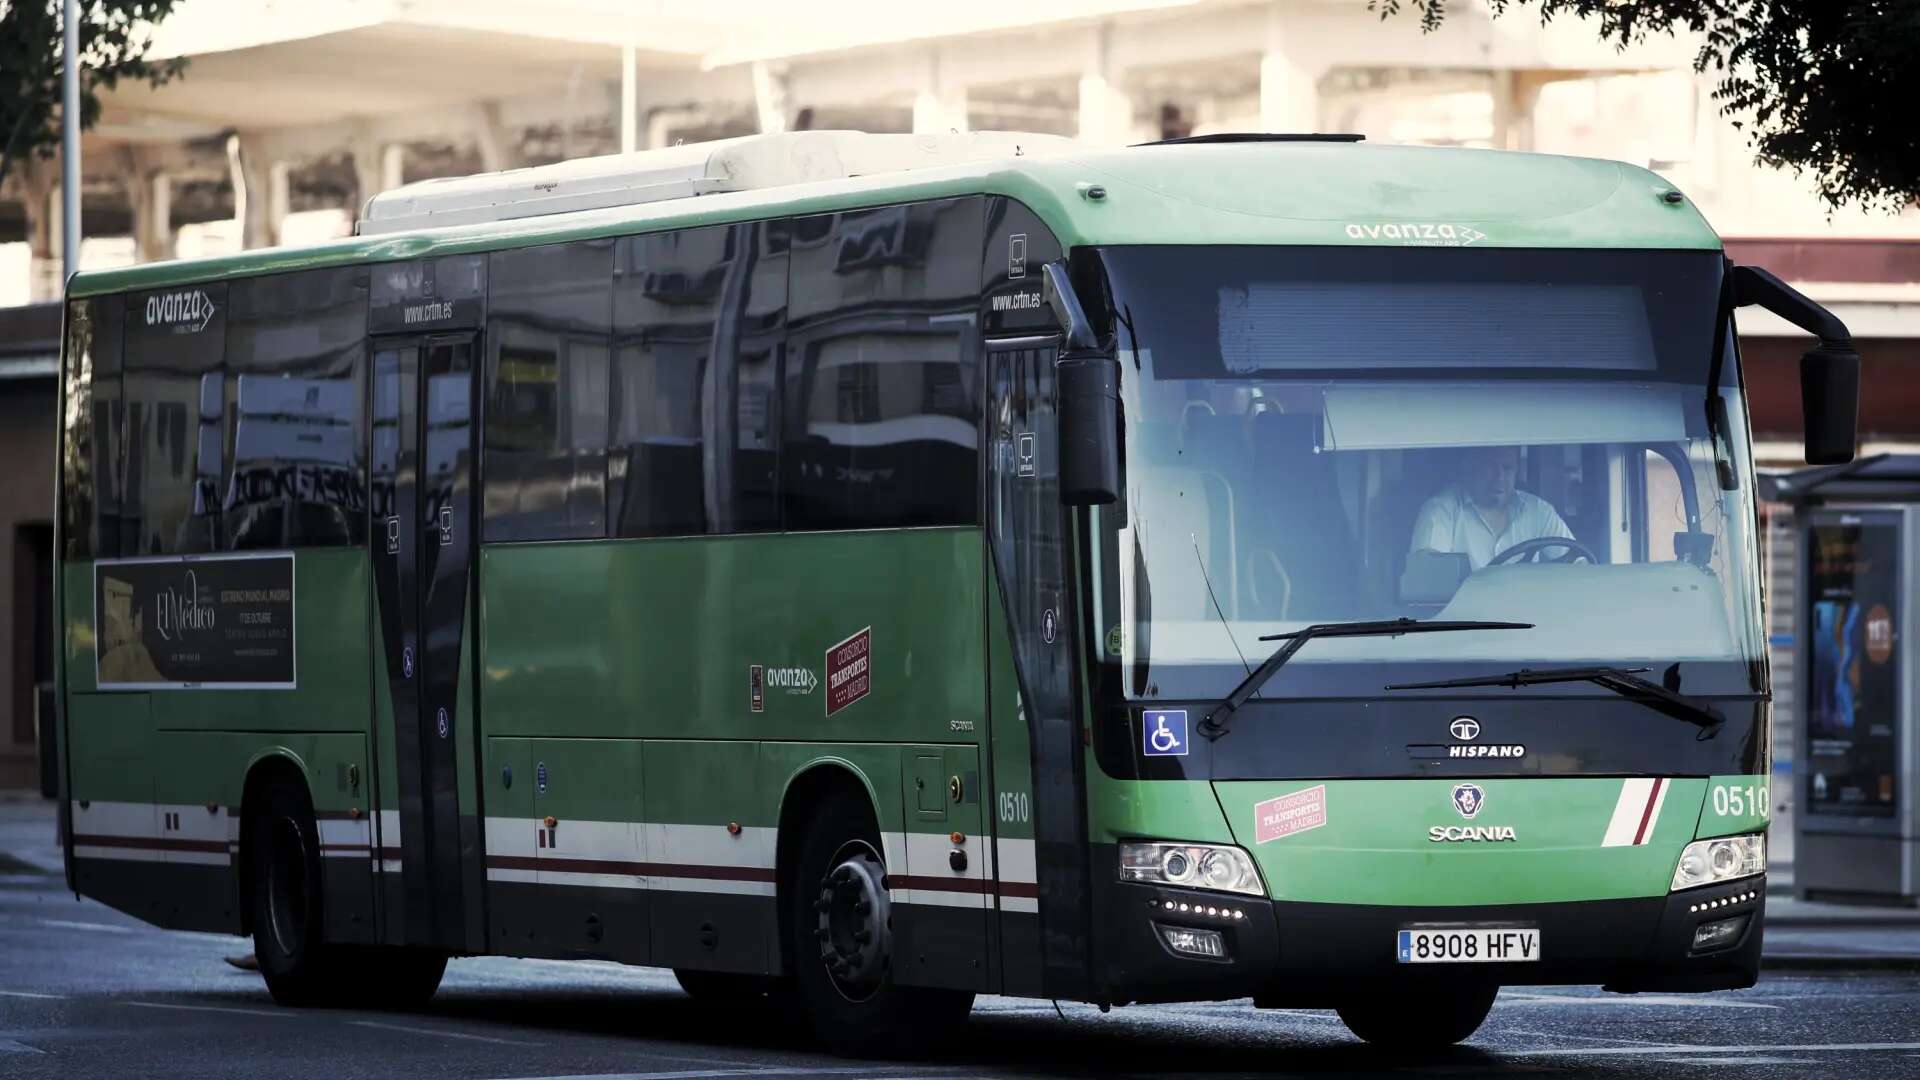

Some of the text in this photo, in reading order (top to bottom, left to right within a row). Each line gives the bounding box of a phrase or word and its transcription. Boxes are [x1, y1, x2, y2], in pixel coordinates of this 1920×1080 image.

[1345, 223, 1457, 239] avanza
[146, 289, 200, 326] avanza
[404, 300, 453, 324] www.crtm.es
[992, 291, 1041, 312] www.crtm.es
[837, 635, 868, 666] CONSORCIO
[767, 667, 808, 687] avanza
[831, 656, 868, 689] TRANSPORTES
[847, 675, 868, 700] MADRID
[950, 720, 975, 731] SCANIA
[1449, 745, 1525, 757] HISPANO
[1000, 791, 1028, 822] 0510
[1713, 785, 1768, 817] 0510
[1263, 803, 1320, 826] TRANSPORTES
[1290, 813, 1321, 829] MADRID
[1429, 825, 1517, 842] SCANIA
[1416, 934, 1478, 958] 8908
[1487, 933, 1533, 958] HFV
